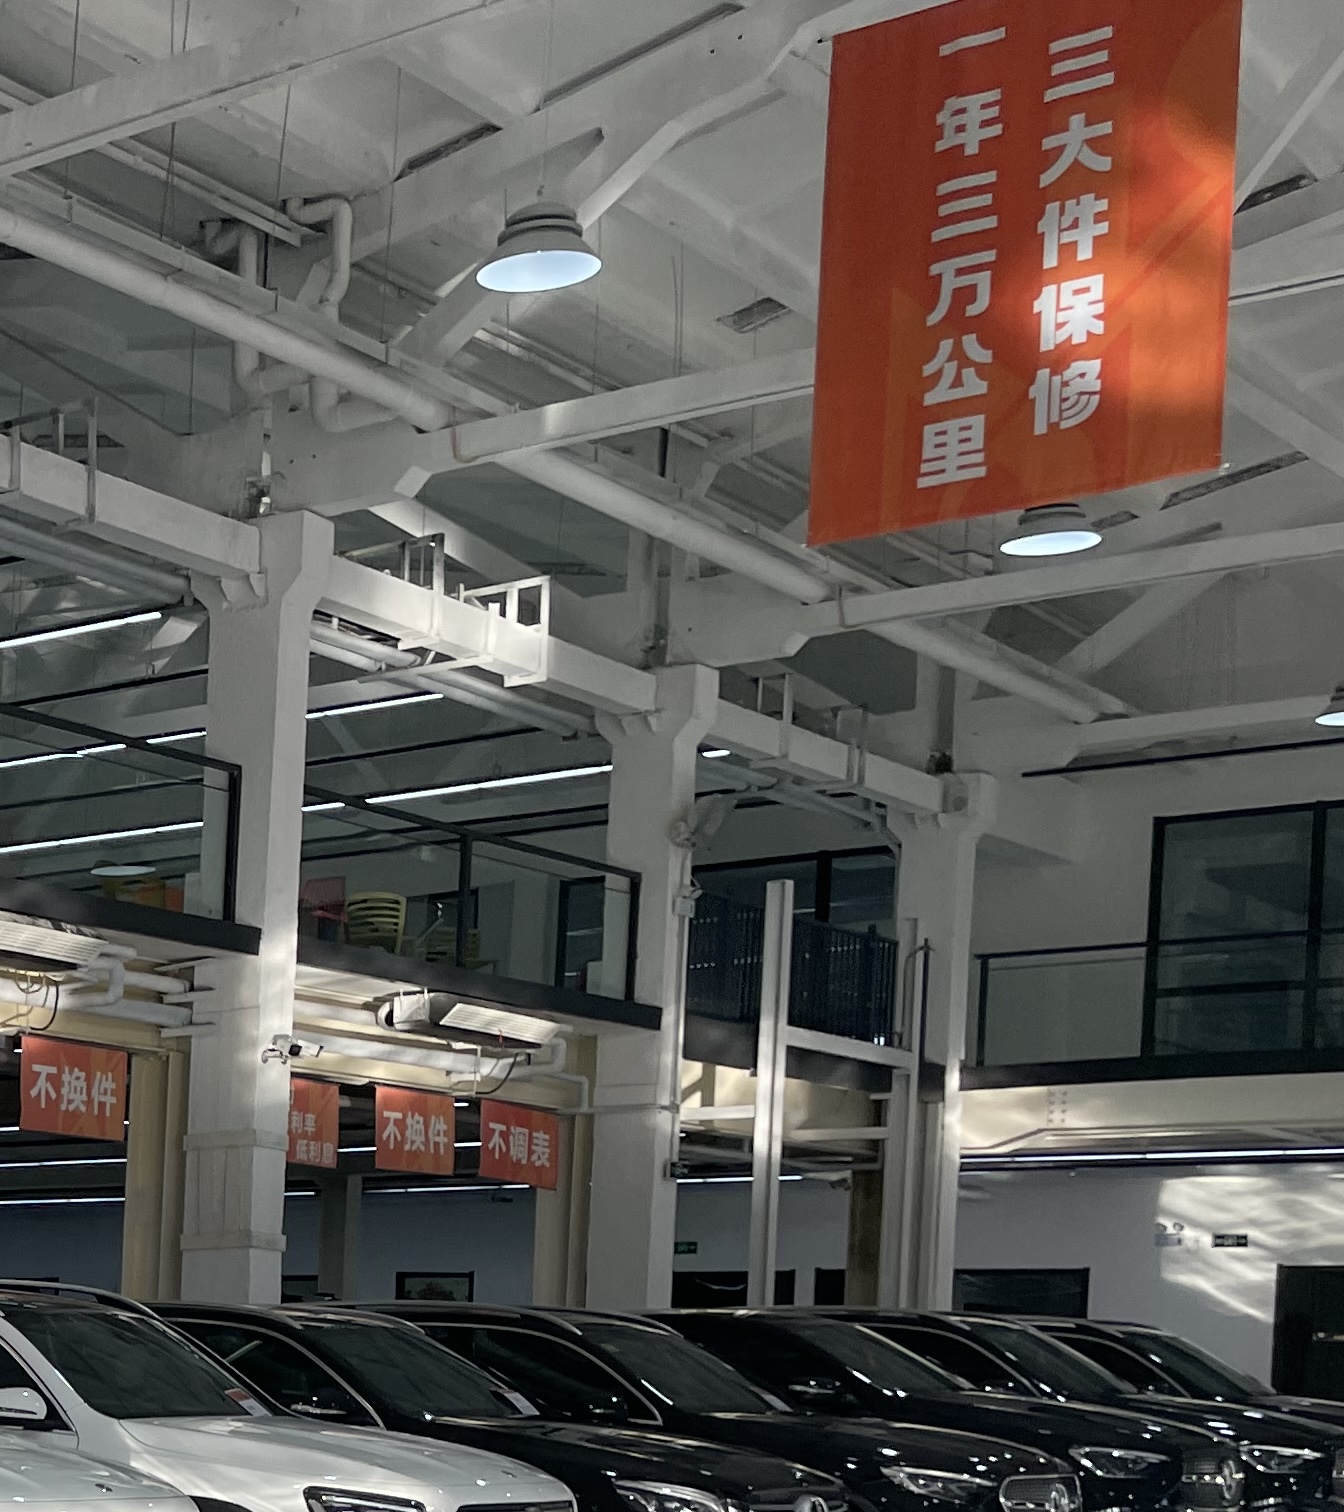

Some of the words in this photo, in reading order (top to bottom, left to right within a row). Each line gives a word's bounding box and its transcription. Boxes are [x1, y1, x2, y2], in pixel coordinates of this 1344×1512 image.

[1029, 26, 1114, 436] 三大件保修
[917, 27, 1006, 489] 一年三万公里
[29, 1064, 118, 1117] 不换件
[296, 1139, 334, 1166] 低利息
[382, 1110, 449, 1155] 不换件
[487, 1121, 551, 1168] 不调表
